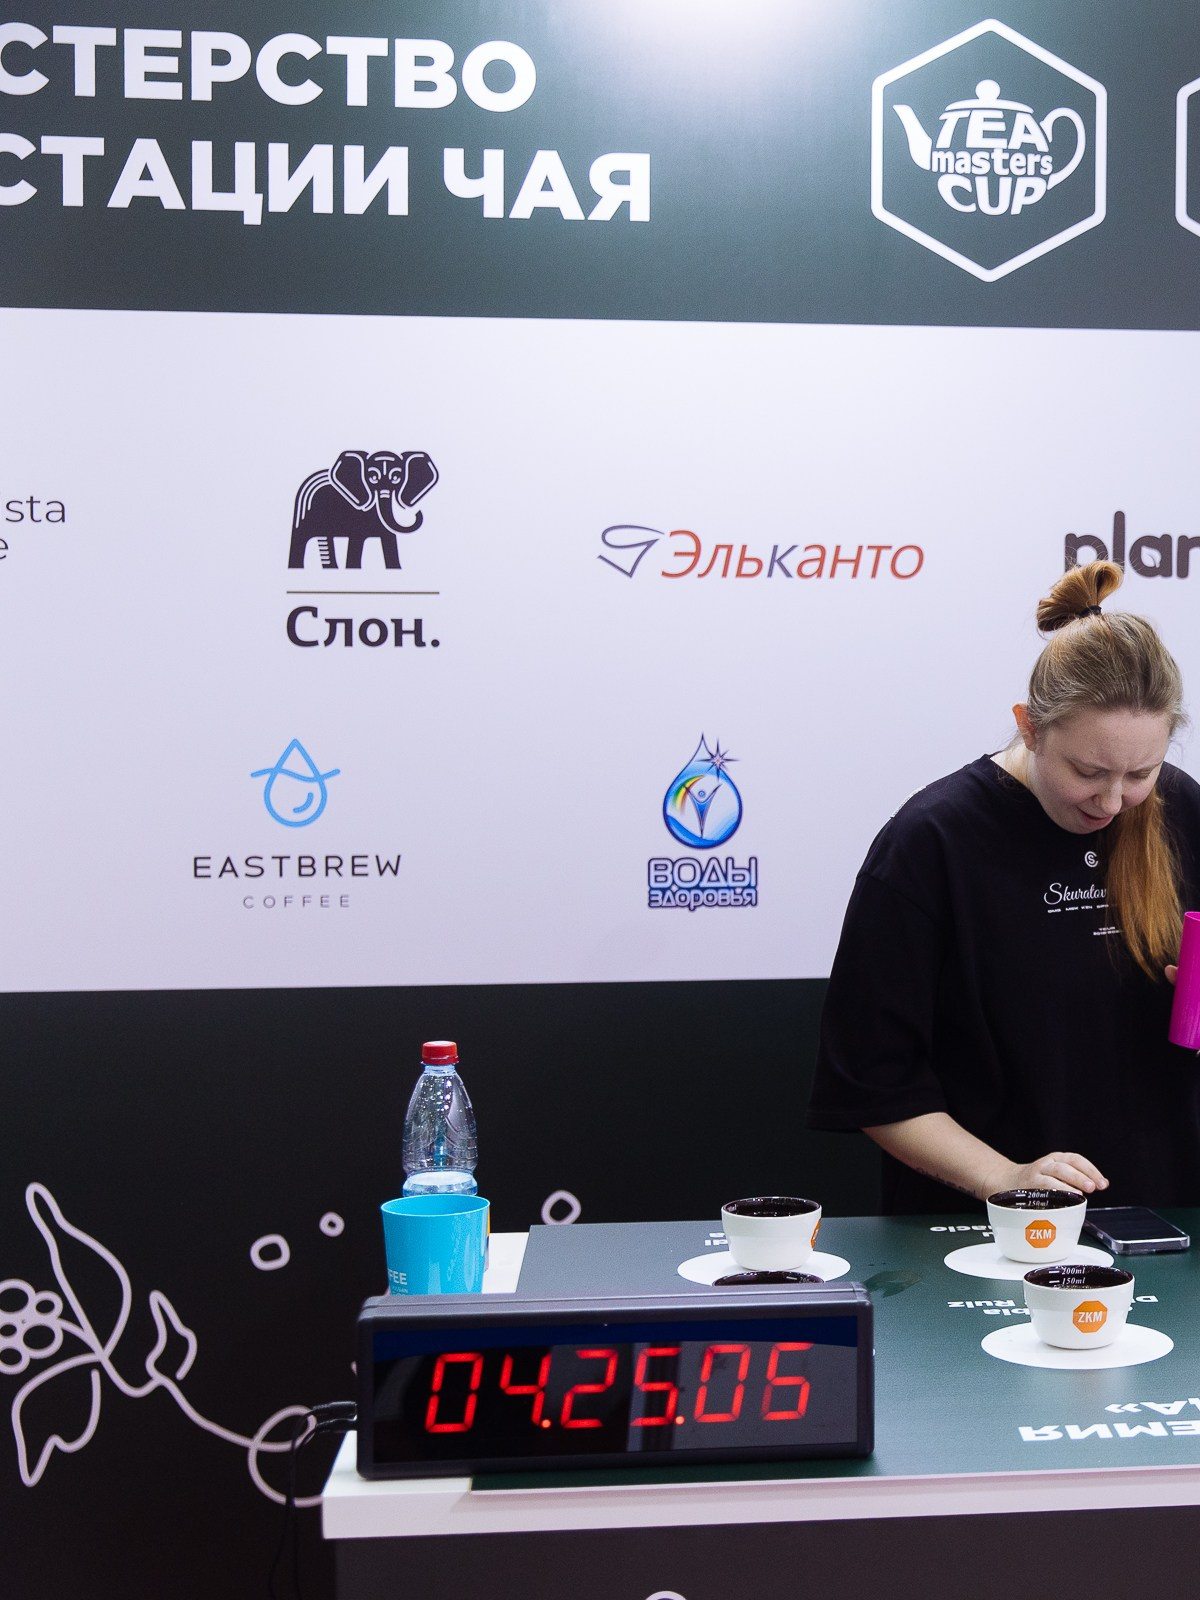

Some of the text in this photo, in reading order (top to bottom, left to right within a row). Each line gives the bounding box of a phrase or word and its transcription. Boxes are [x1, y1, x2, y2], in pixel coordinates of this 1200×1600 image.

[0, 22, 537, 113] СТЕРСТВО
[935, 110, 1049, 151] TEA
[931, 147, 1053, 176] masters
[0, 132, 651, 225] СТАЦИИ ЧАЯ
[937, 174, 1049, 215] CUP
[4, 496, 67, 523] sta
[660, 529, 926, 579] Эльканто
[286, 606, 440, 648] Слон.
[193, 854, 401, 878] EASTBREW
[648, 856, 758, 889] ВОДЫ
[243, 894, 350, 909] COFFEE
[1043, 882, 1107, 905] Skuratov
[1028, 1191, 1049, 1199] 200ml
[1029, 1228, 1053, 1240] ZKM
[388, 1268, 408, 1286] FEE
[1061, 1267, 1086, 1275] 200ml
[1062, 1277, 1086, 1285] 150ml
[1077, 1310, 1104, 1323] ZKM
[425, 1341, 815, 1434] 04.25.06
